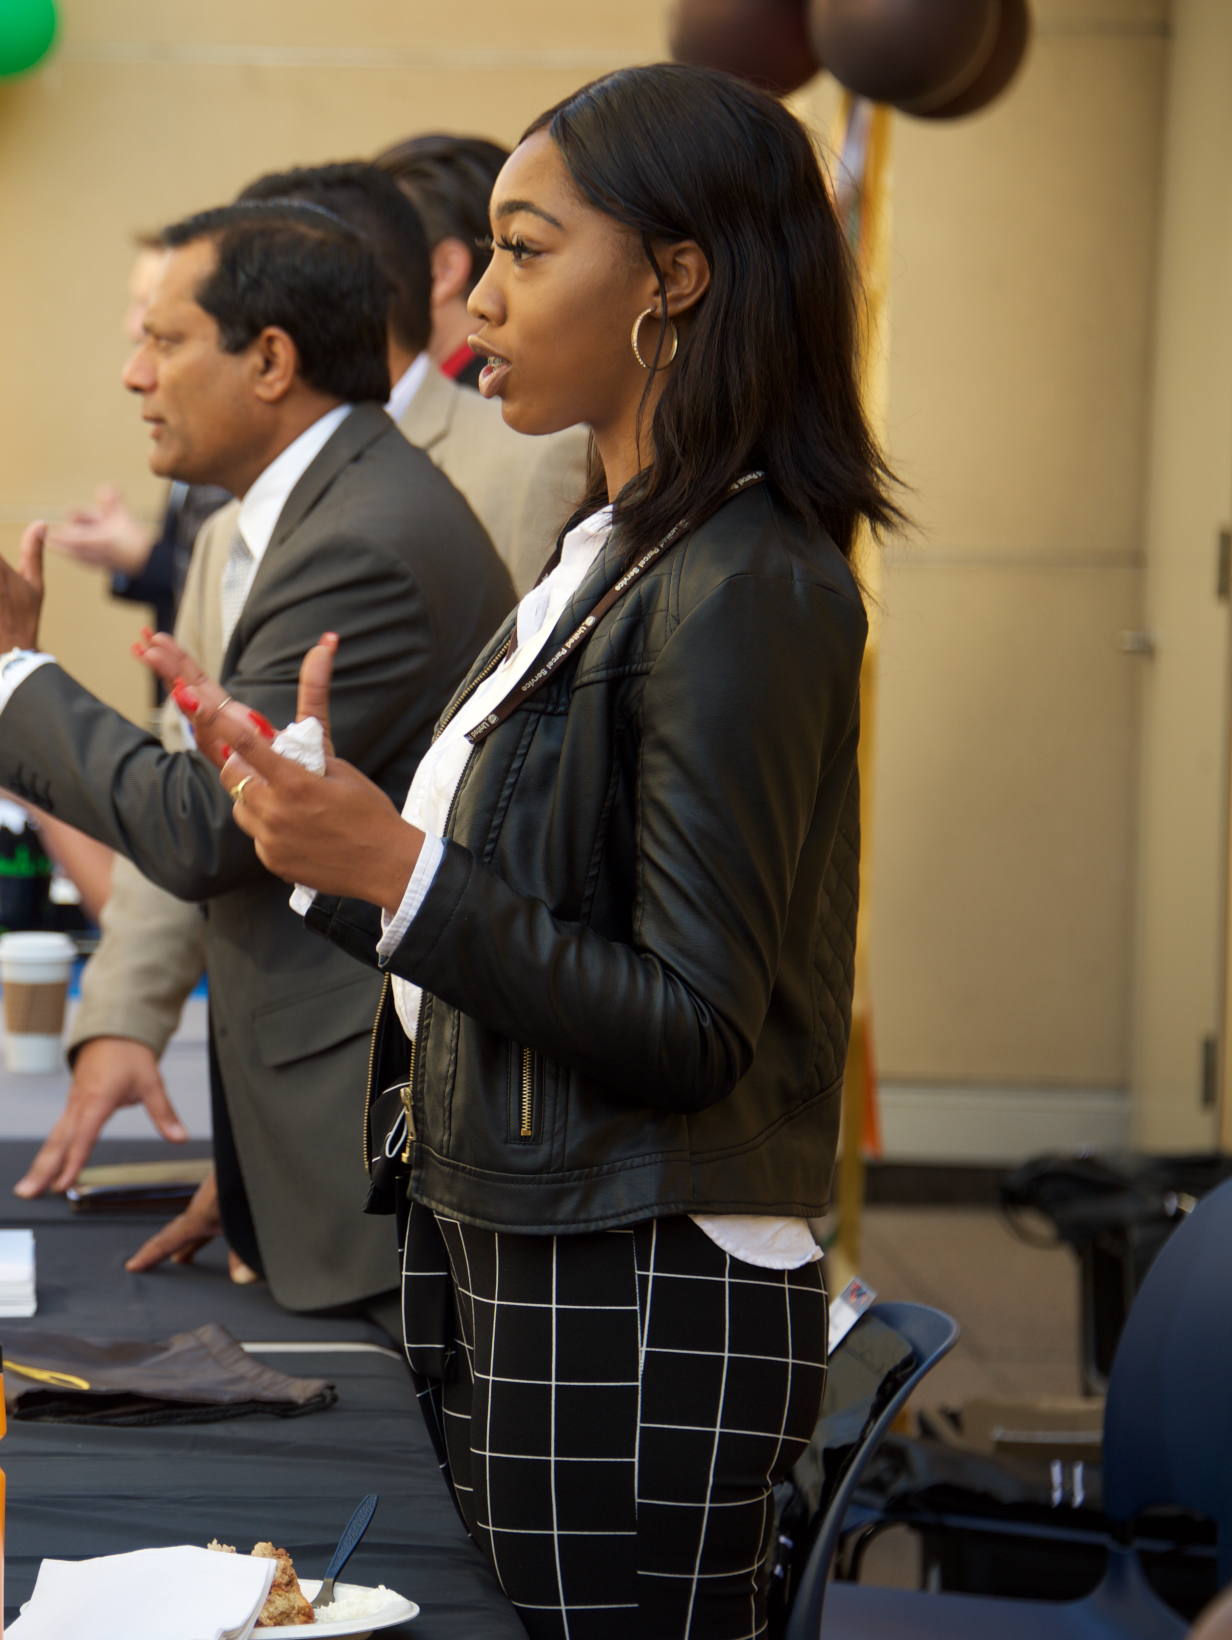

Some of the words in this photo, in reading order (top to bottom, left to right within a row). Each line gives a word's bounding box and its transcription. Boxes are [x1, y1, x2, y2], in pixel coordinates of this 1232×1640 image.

[638, 547, 660, 568] Parcel
[614, 566, 640, 591] Service
[565, 625, 587, 648] United
[546, 647, 568, 669] Parcel
[521, 668, 547, 691] Service
[470, 721, 489, 738] United
